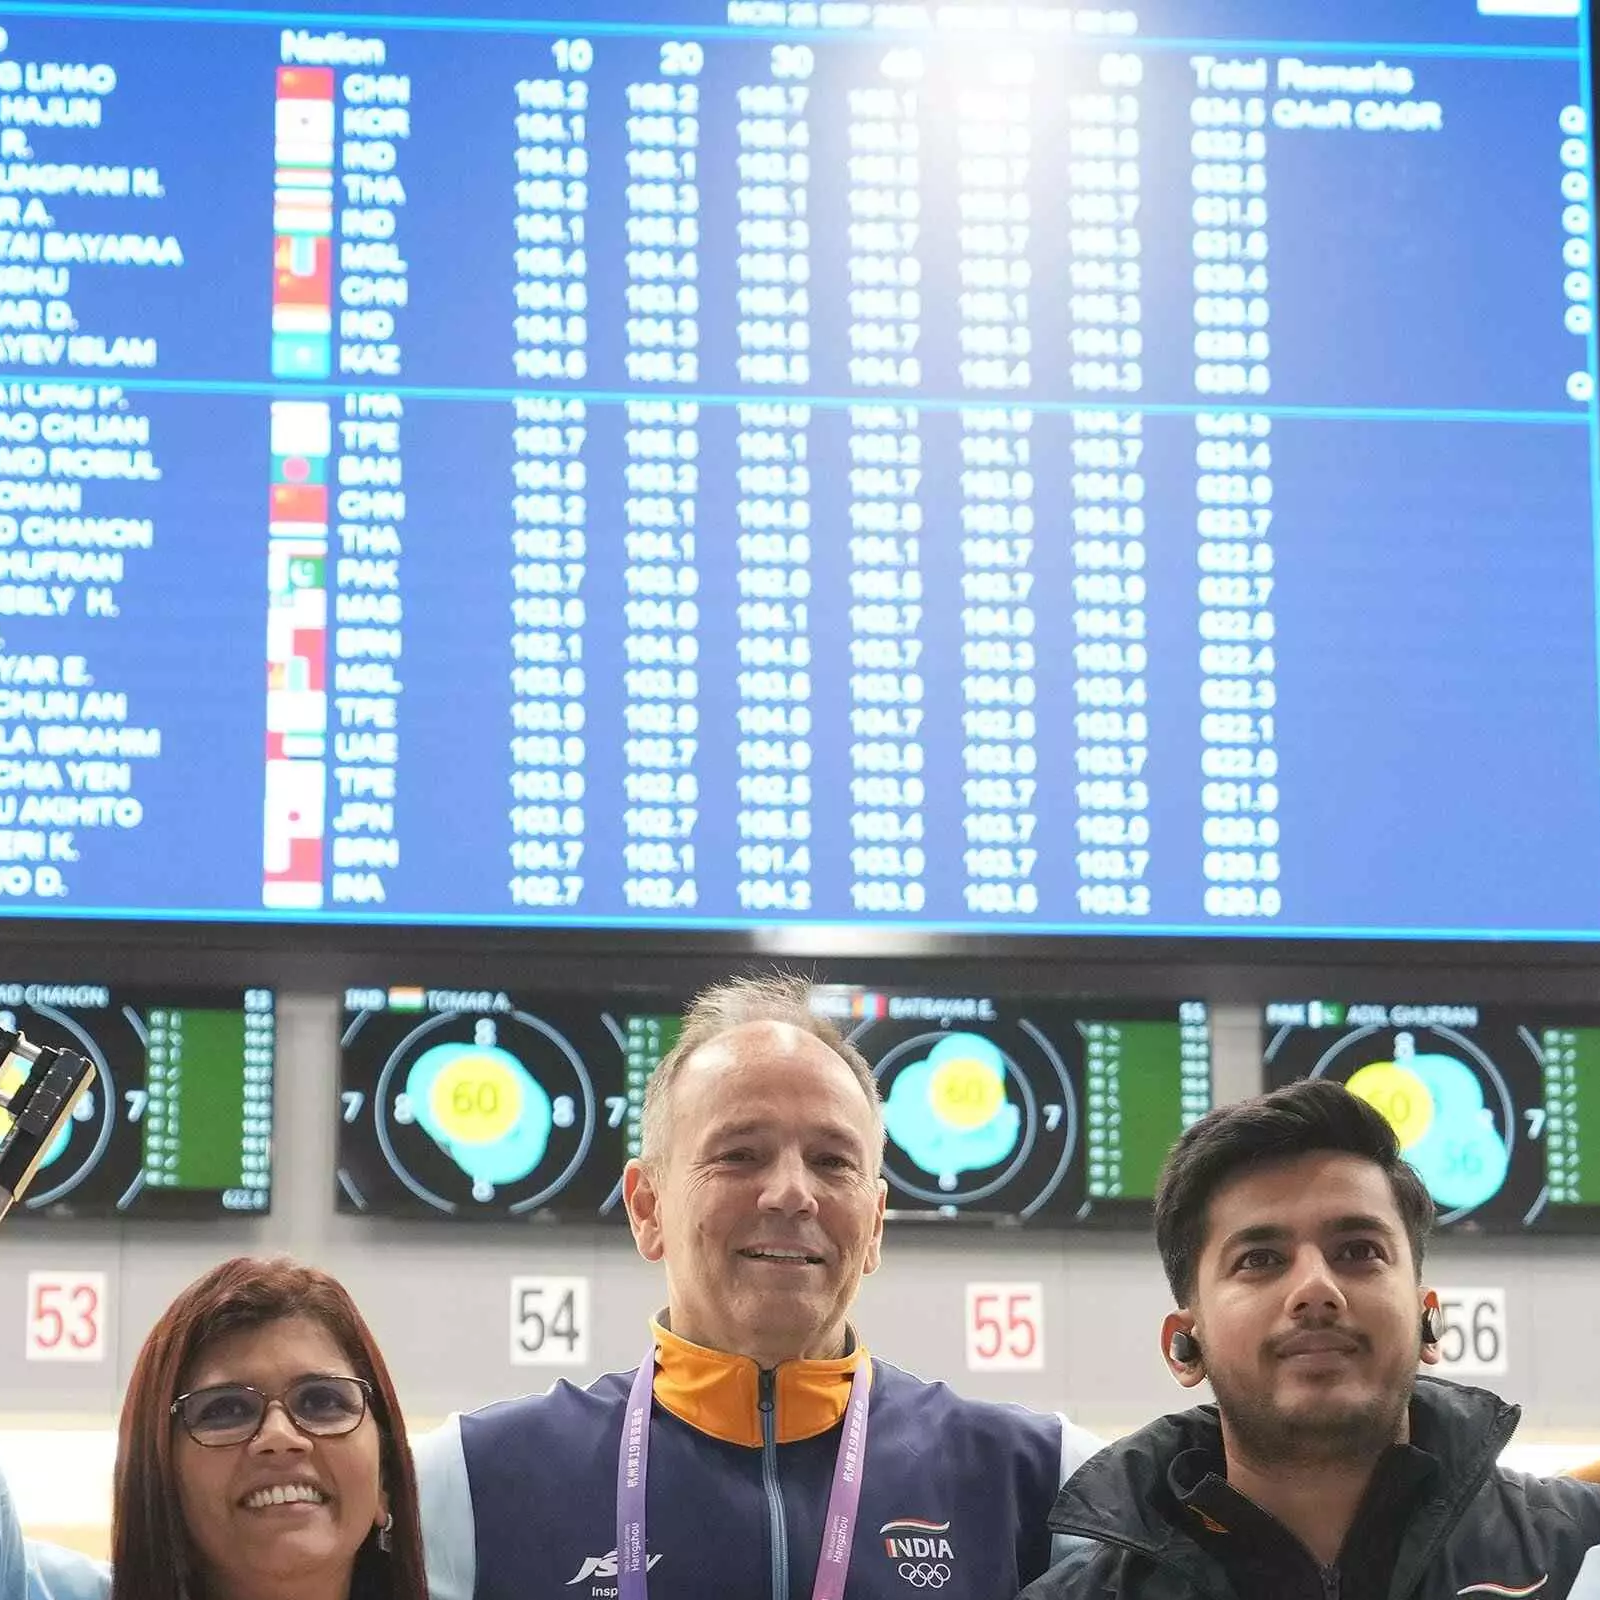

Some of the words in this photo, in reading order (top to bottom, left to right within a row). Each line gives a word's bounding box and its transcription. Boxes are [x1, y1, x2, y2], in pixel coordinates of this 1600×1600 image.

[280, 29, 385, 66] Nation
[552, 38, 593, 71] 10
[1189, 55, 1267, 91] Total
[339, 345, 401, 375] KAZ
[337, 525, 402, 555] THA
[453, 1082, 499, 1114] 60
[606, 1097, 628, 1128] 7
[1524, 1109, 1546, 1140] 7
[35, 1285, 99, 1349] 53
[519, 1289, 580, 1353] 54
[974, 1295, 1037, 1359] 55
[1442, 1301, 1501, 1363] 56
[631, 1522, 641, 1572] Hangzhou
[833, 1516, 849, 1564] Hangzhou
[885, 1537, 954, 1561] INDIA
[591, 1586, 619, 1599] Insp
